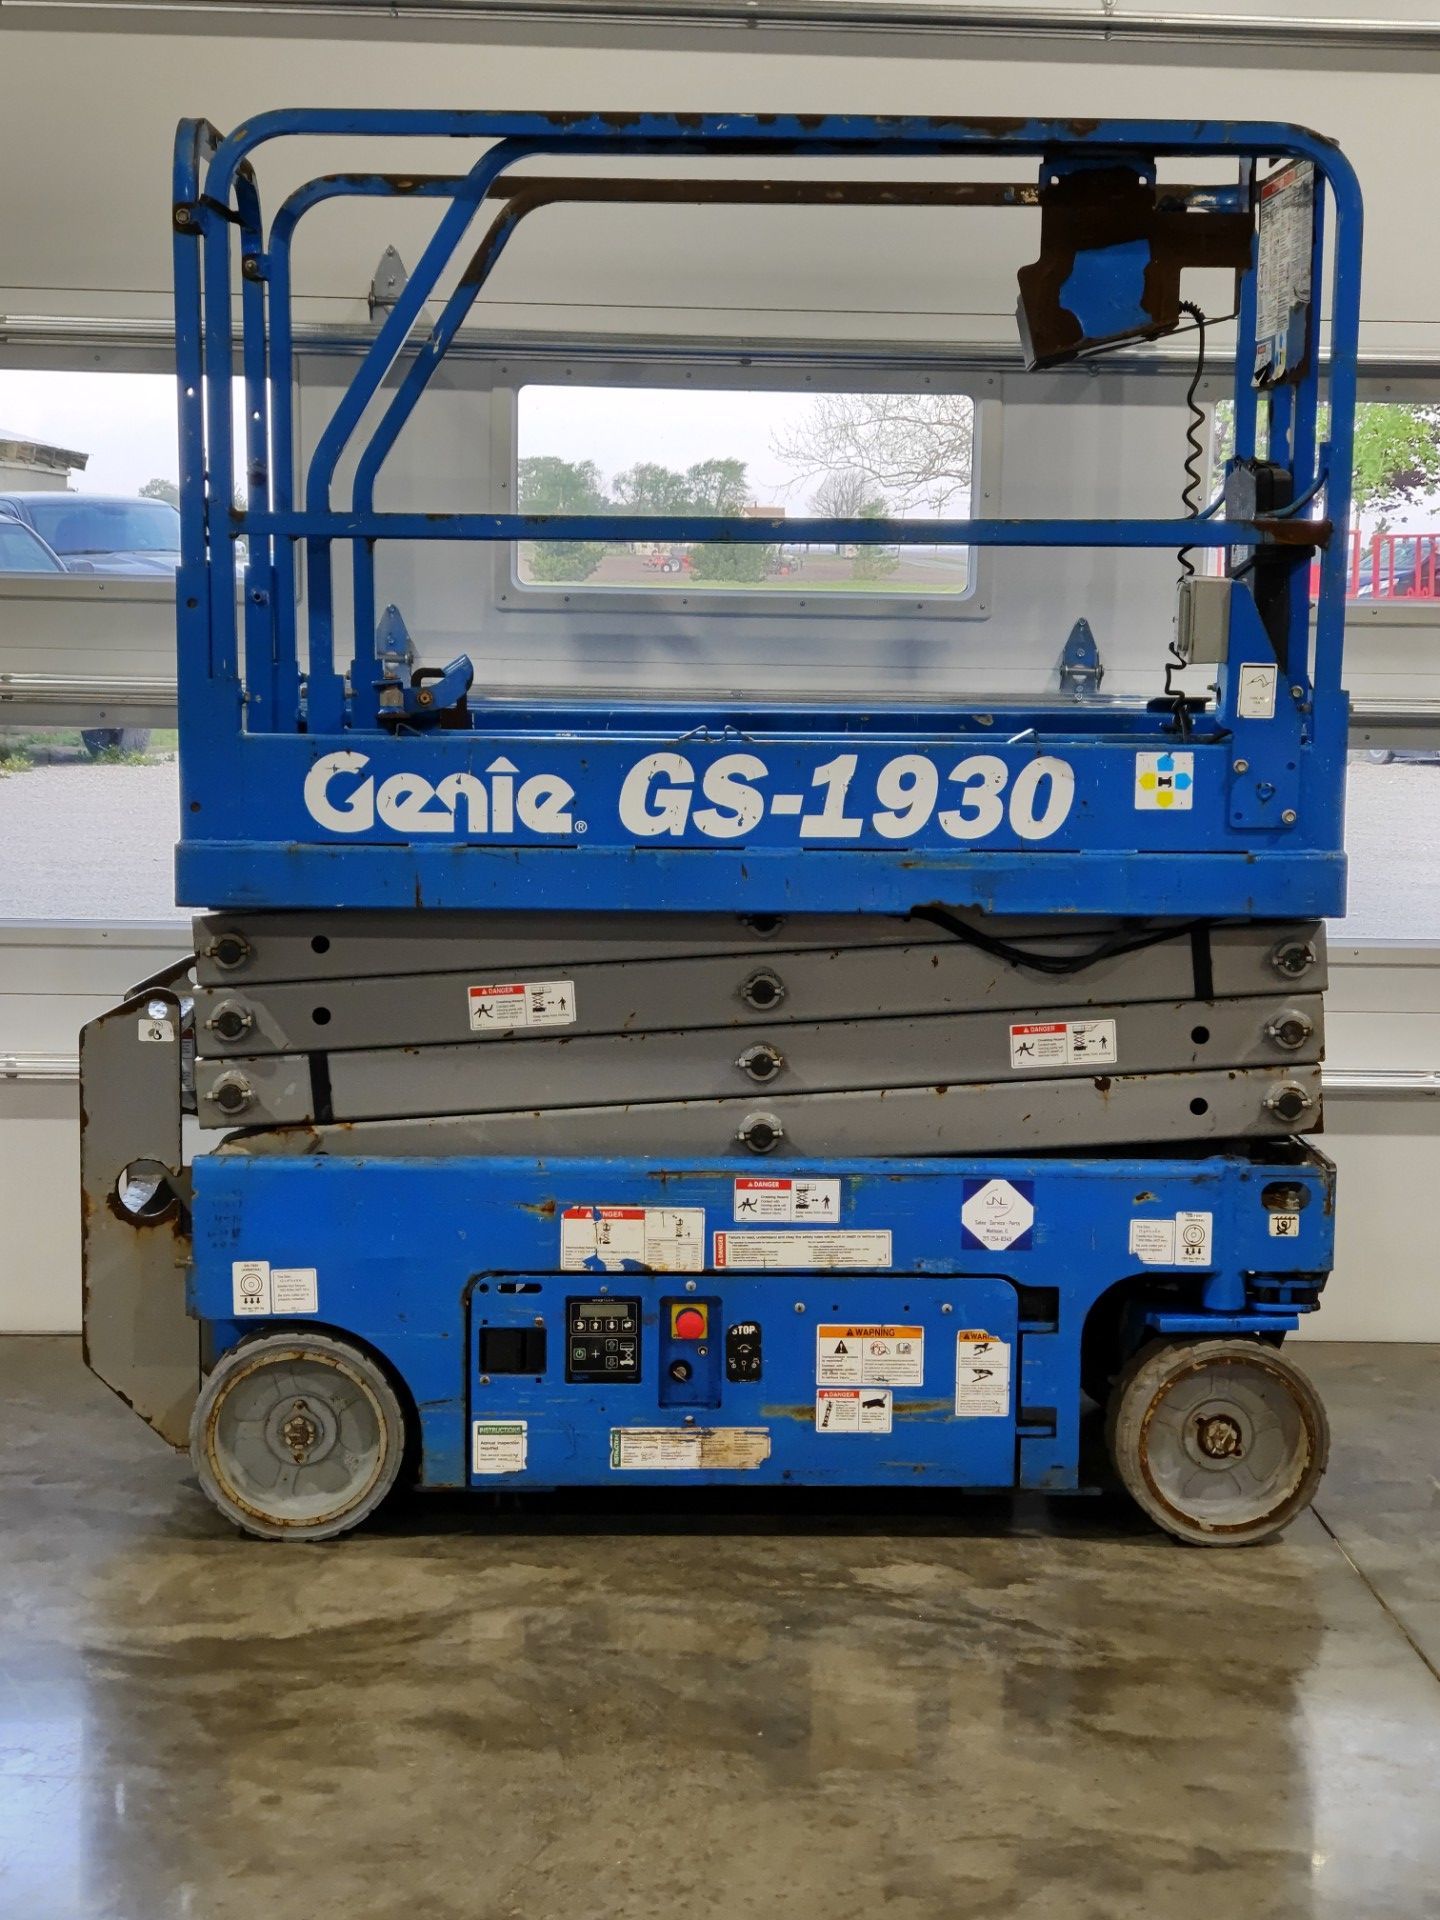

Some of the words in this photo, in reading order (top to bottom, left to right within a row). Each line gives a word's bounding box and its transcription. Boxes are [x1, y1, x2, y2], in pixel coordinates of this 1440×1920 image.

[619, 752, 1074, 839] GS-1930
[732, 1325, 755, 1335] STOP
[856, 1328, 895, 1336] WARNING
